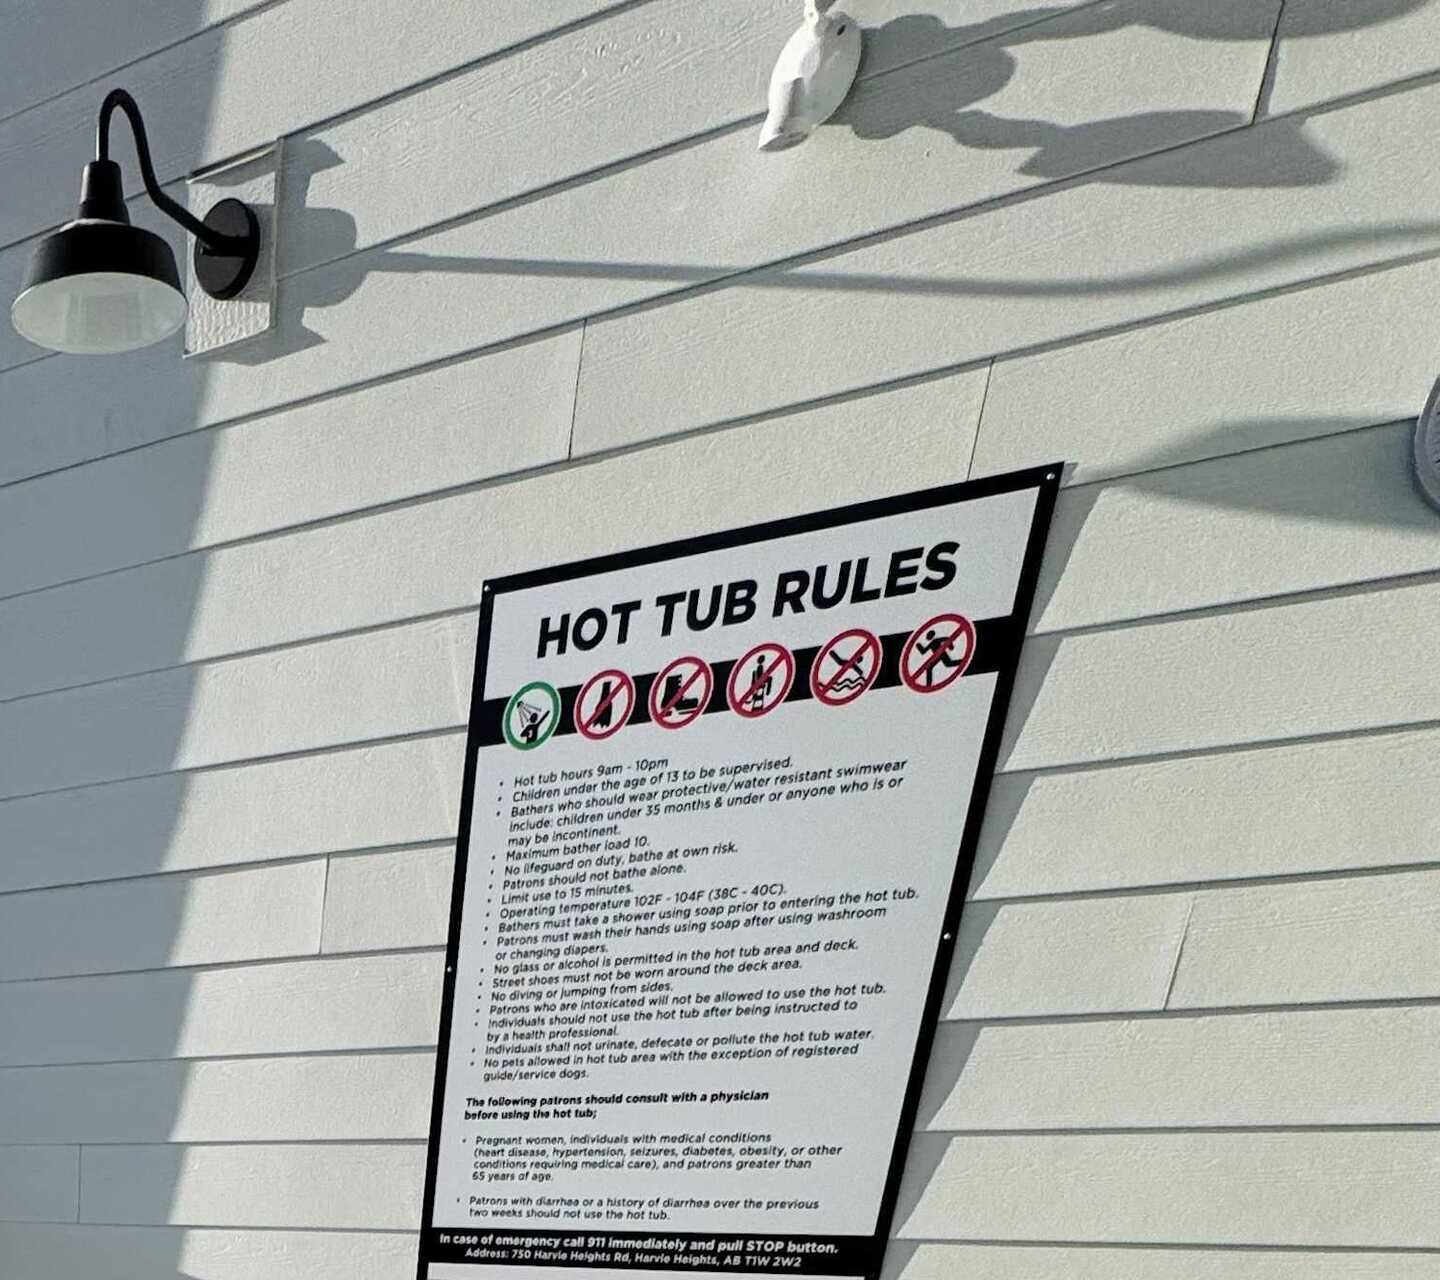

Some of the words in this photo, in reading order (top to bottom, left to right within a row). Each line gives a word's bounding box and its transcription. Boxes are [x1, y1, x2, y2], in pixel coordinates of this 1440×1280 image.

[536, 599, 642, 660] HOT
[655, 579, 758, 638] TUB
[771, 540, 961, 618] RULES
[512, 787, 561, 803] Children
[563, 781, 599, 797] under
[600, 778, 621, 792] the
[623, 776, 647, 790] age
[649, 771, 665, 786] of
[666, 769, 680, 784] 13
[682, 769, 697, 782] to
[698, 765, 717, 780] be
[513, 775, 535, 789] Hot
[538, 770, 558, 785] tub
[560, 768, 594, 782] hours
[596, 764, 624, 777] 9am
[635, 758, 669, 773] 10pm
[510, 803, 554, 819] Bathers
[557, 799, 583, 813] who
[584, 792, 626, 809] should
[628, 790, 660, 803] wear
[660, 776, 772, 802] protective/water
[774, 767, 833, 786] resistant
[835, 759, 909, 779] swimwear
[556, 812, 604, 827] children
[606, 807, 643, 821] under
[645, 803, 661, 817] 35
[663, 798, 711, 815] months
[713, 795, 724, 809] &
[726, 792, 766, 808] under
[768, 791, 784, 803] or
[785, 784, 836, 801] anyone
[839, 779, 870, 795] who
[872, 777, 885, 791] is
[887, 776, 905, 789] or
[505, 847, 560, 862] Maximum
[562, 842, 602, 856] bather
[604, 836, 631, 851] load
[507, 836, 532, 848] may
[534, 832, 550, 845] be
[504, 865, 521, 877] No
[576, 858, 593, 869] on
[628, 849, 664, 864] bathe
[665, 847, 680, 860] at
[682, 846, 710, 858] own
[502, 877, 545, 891] Patrons
[548, 871, 587, 887] should
[589, 870, 610, 882] not
[612, 866, 647, 880] bathe
[499, 905, 556, 920] Operating
[559, 898, 631, 915] temperature
[634, 893, 664, 908] 102F
[674, 889, 706, 904] 104F
[707, 886, 740, 902] (38C
[501, 892, 530, 906] Limit
[532, 891, 552, 902] use
[554, 889, 567, 900] to
[570, 886, 582, 899] 15
[498, 921, 540, 934] Bathers
[543, 917, 571, 929] must
[574, 915, 600, 928] take
[612, 911, 656, 924] shower
[658, 906, 692, 920] using
[694, 905, 725, 917] soap
[727, 901, 760, 917] prior
[762, 900, 777, 911] to
[779, 894, 836, 910] entering
[839, 892, 862, 905] the
[864, 889, 889, 903] hot
[492, 976, 526, 989] Street
[528, 975, 560, 987] shoes
[562, 972, 591, 984] must
[593, 970, 613, 982] not
[615, 968, 632, 981] be
[634, 968, 664, 979] worn
[666, 962, 712, 977] around
[713, 962, 735, 975] the
[737, 959, 769, 973] deck
[490, 991, 507, 1002] No
[509, 990, 544, 1002] diving
[545, 989, 559, 999] or
[559, 985, 607, 1001] jumping
[609, 983, 638, 995] from
[483, 1069, 557, 1083] guide/service
[465, 1097, 486, 1108] The
[487, 1095, 538, 1109] following
[539, 1095, 583, 1108] patrons
[584, 1093, 624, 1105] should
[625, 1092, 669, 1104] consult
[670, 1091, 698, 1103] with
[709, 1089, 770, 1105] physician
[463, 1109, 499, 1121] before
[500, 1108, 531, 1121] using
[532, 1108, 551, 1120] the
[552, 1107, 573, 1119] hot
[475, 1135, 523, 1147] Pregnant
[569, 1133, 629, 1145] individuals
[632, 1133, 657, 1145] with
[659, 1132, 707, 1144] medical
[708, 1131, 772, 1144] conditions
[525, 1207, 561, 1219] should
[563, 1208, 582, 1219] not
[583, 1210, 603, 1219] use
[605, 1209, 624, 1220] the
[626, 1209, 646, 1220] hot
[439, 1233, 451, 1244] In
[452, 1235, 479, 1245] case
[480, 1233, 494, 1245] of
[495, 1236, 561, 1249] emergency
[563, 1236, 585, 1248] call
[587, 1236, 606, 1248] 911
[607, 1237, 688, 1252] immediately
[689, 1239, 716, 1251] and
[716, 1239, 744, 1253] pull
[746, 1240, 785, 1253] STOP
[511, 1249, 532, 1259] 750
[533, 1249, 568, 1260] Harvie
[570, 1250, 611, 1263] Heights
[634, 1252, 671, 1264] Harvie
[723, 1255, 742, 1266] AB
[745, 1255, 771, 1266] T1W
[772, 1256, 802, 1267] 2W2
